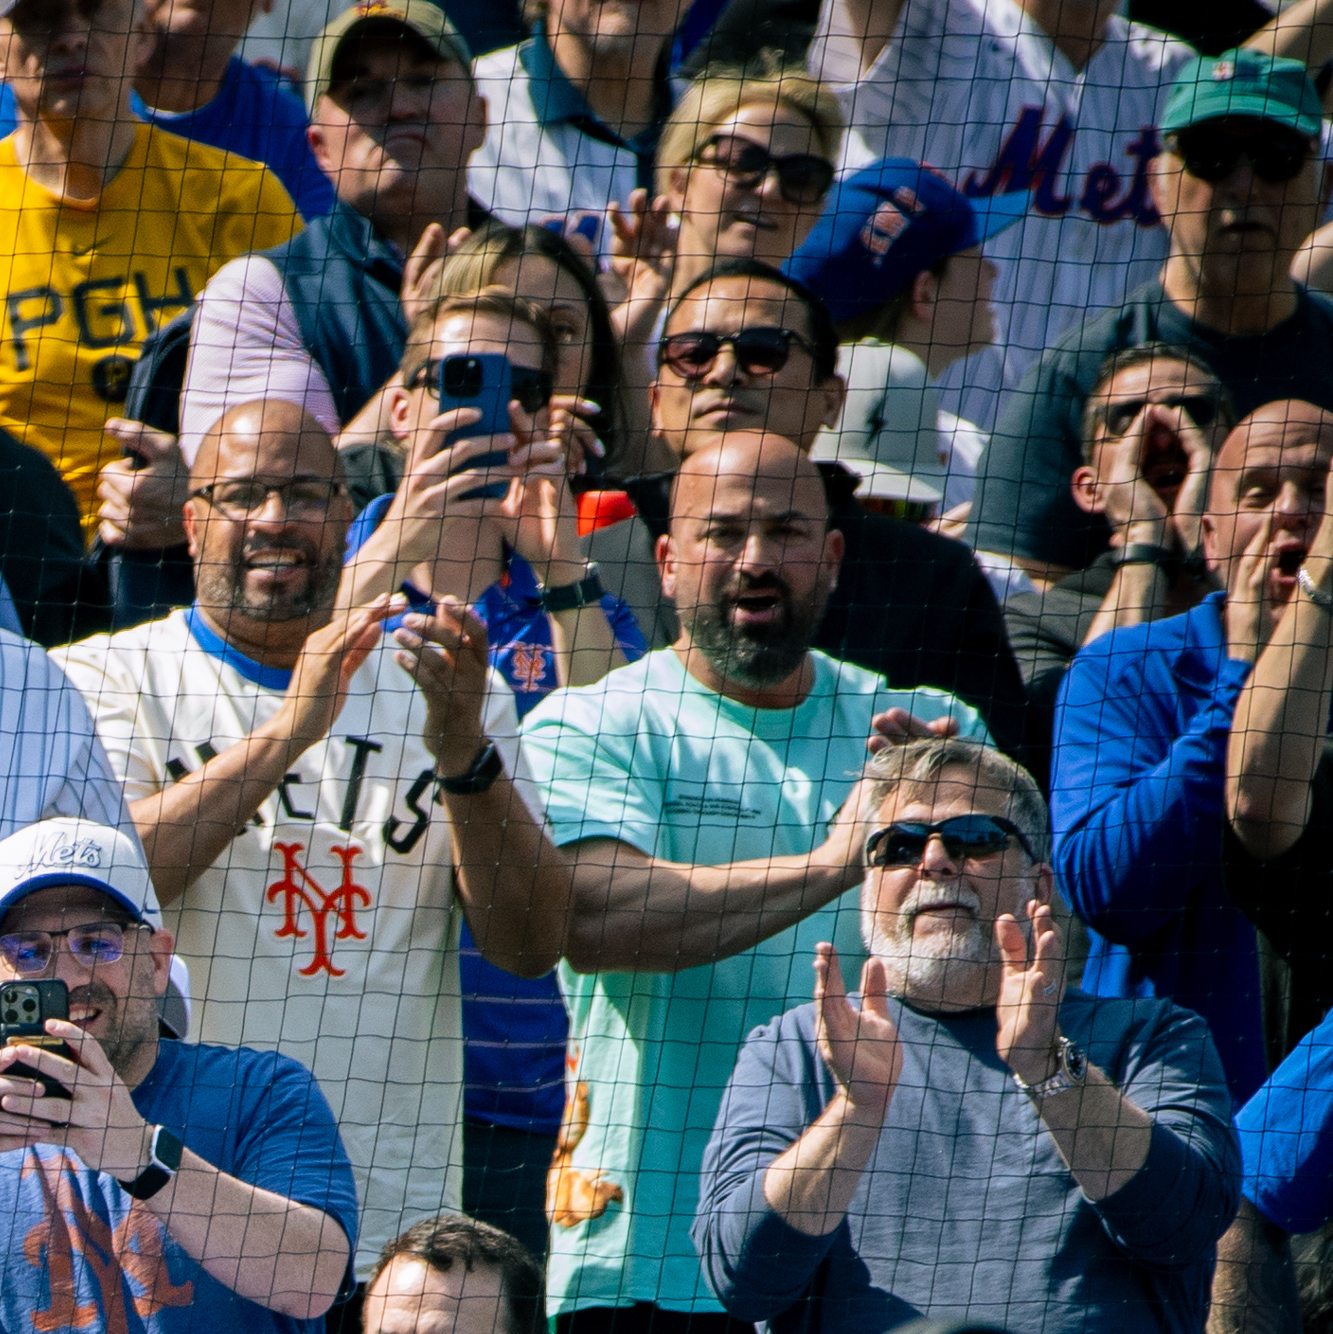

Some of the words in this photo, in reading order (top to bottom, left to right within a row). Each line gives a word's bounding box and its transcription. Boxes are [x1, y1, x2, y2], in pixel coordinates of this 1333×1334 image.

[962, 104, 1162, 227] Met
[7, 266, 197, 372] PGH
[14, 831, 102, 880] Mets
